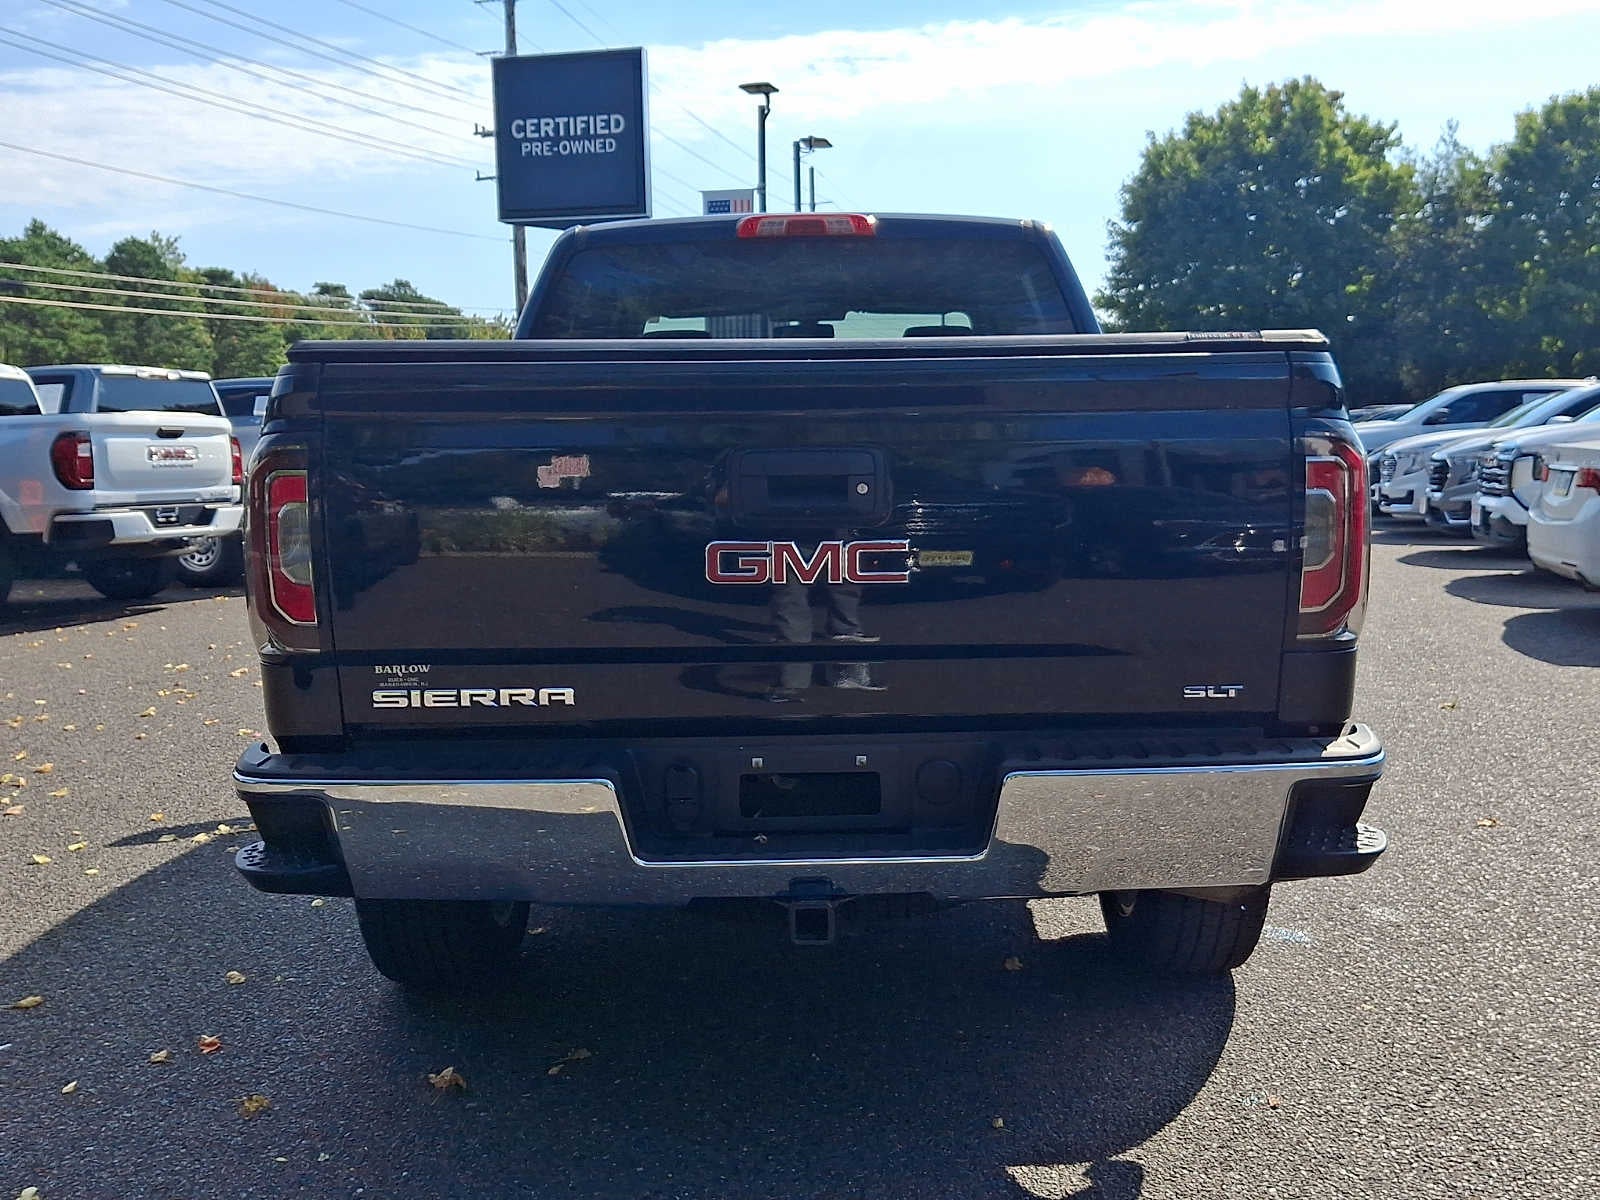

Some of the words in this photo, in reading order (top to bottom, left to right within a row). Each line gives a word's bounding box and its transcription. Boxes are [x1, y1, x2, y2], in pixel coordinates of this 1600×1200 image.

[511, 113, 626, 140] CERTIFIED
[521, 138, 617, 157] PRE-OWNED
[705, 539, 910, 585] GMC
[374, 664, 432, 677] BARLOW
[371, 688, 576, 708] SIERRA
[1183, 685, 1244, 698] SLT
